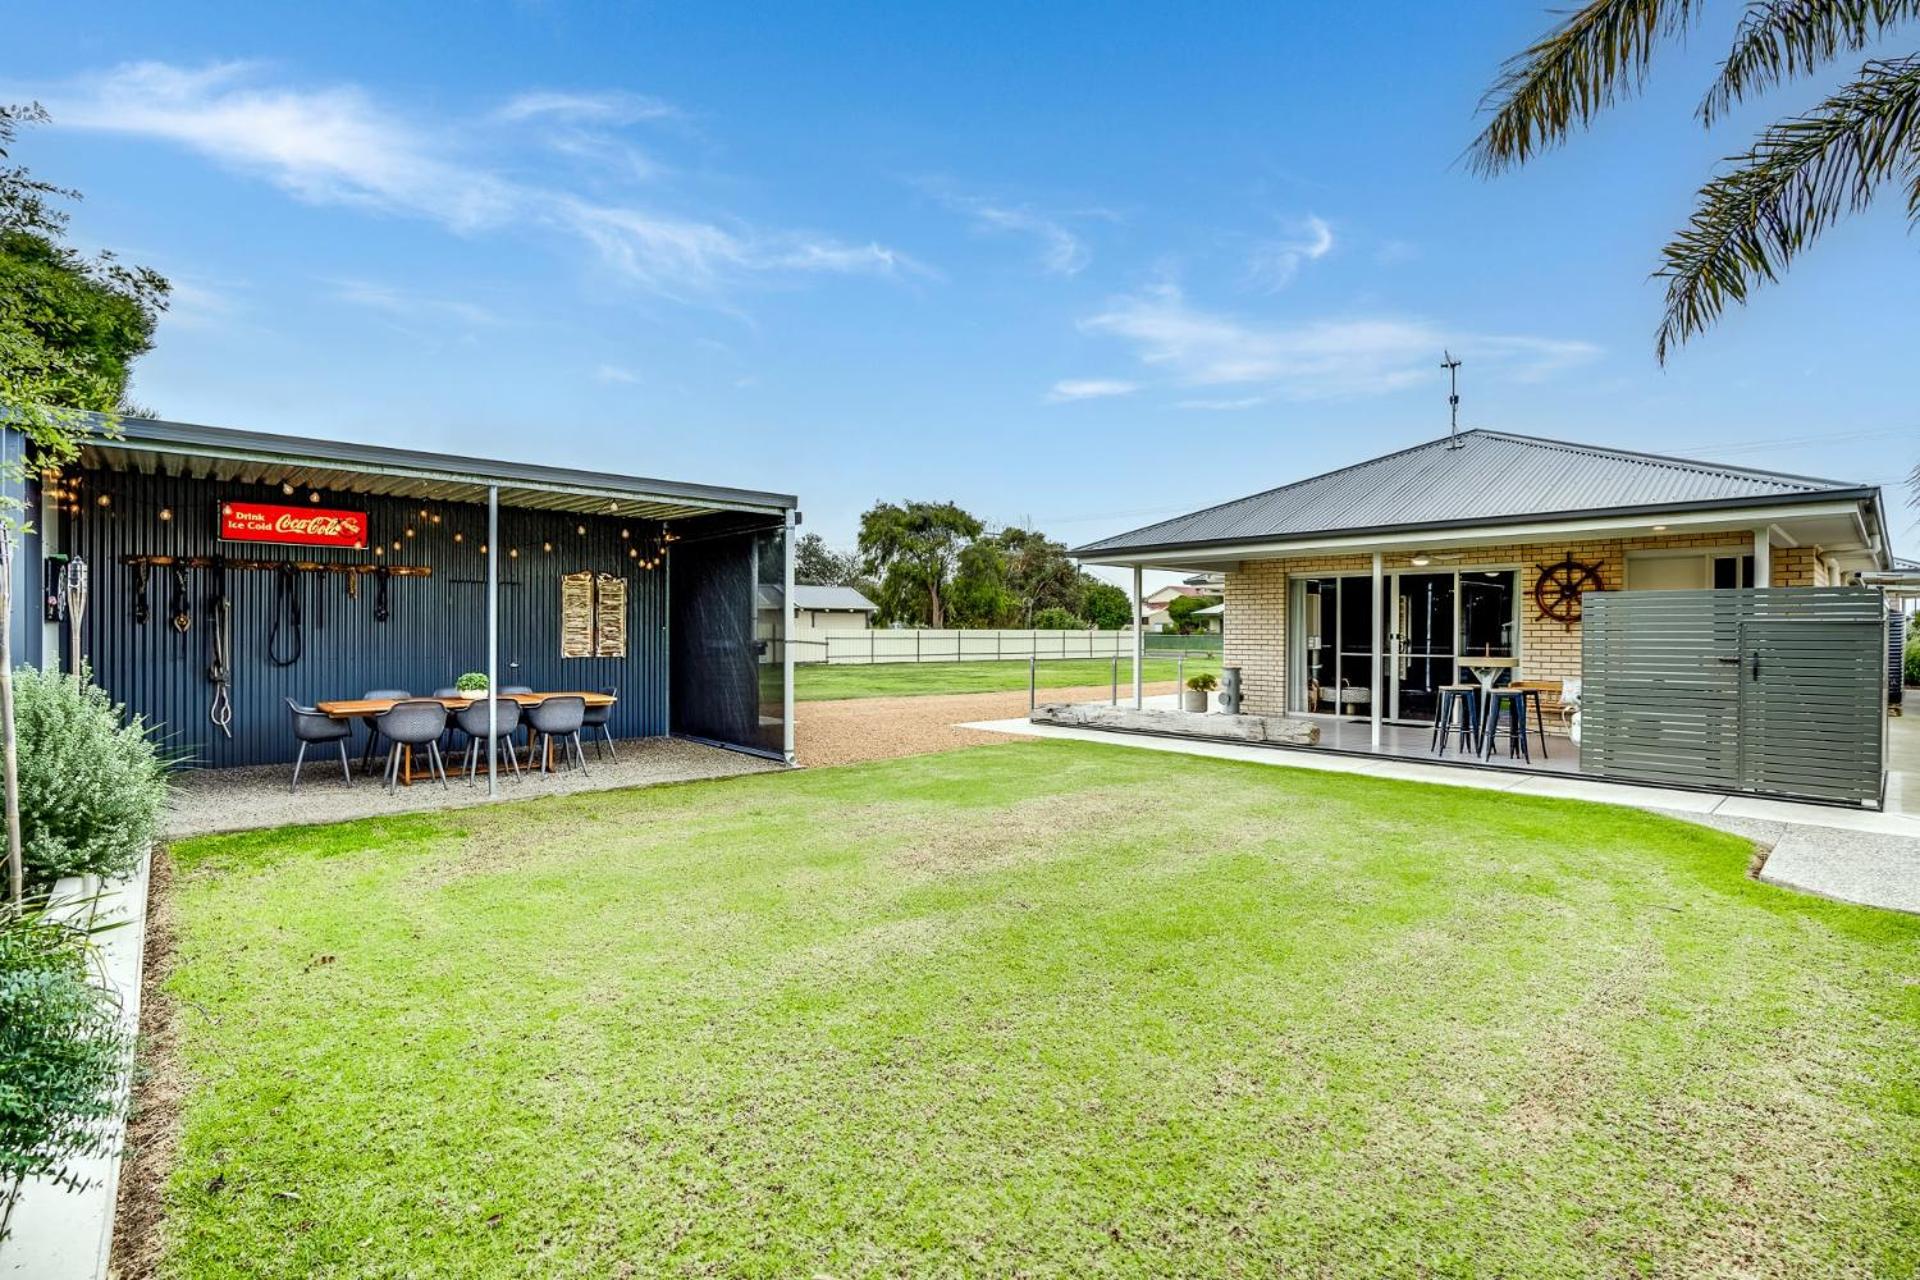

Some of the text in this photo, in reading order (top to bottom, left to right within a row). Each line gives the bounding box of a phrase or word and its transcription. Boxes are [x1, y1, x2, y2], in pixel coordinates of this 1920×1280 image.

[235, 511, 265, 521] Drink
[228, 520, 272, 531] Ice Cold
